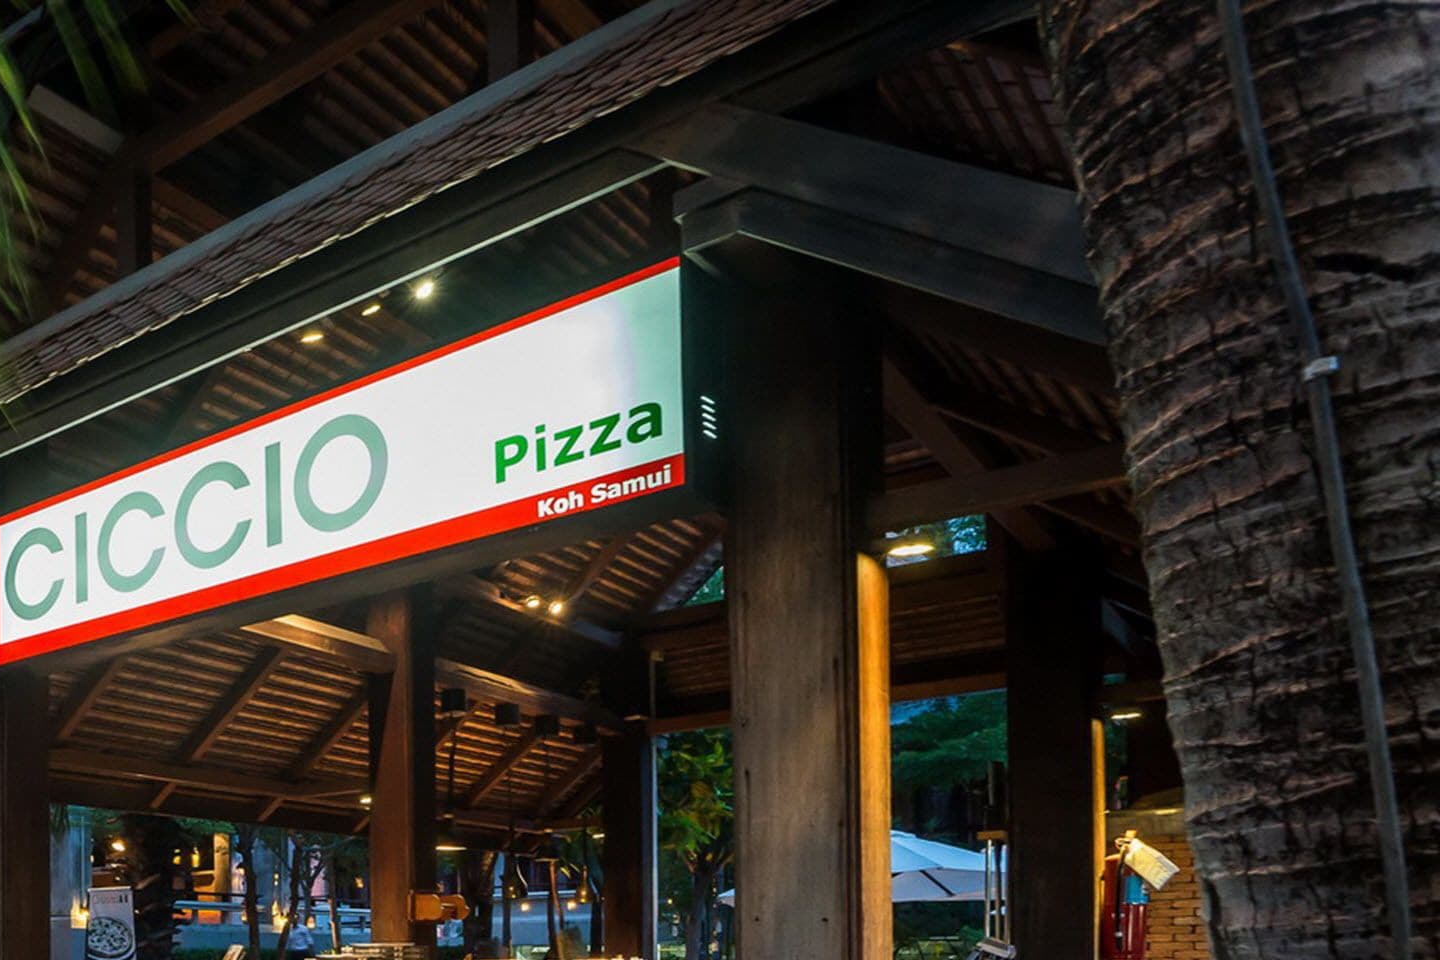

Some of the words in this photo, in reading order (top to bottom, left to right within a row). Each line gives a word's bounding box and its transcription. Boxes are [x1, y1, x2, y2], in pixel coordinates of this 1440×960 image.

[495, 402, 663, 484] Pizza
[5, 414, 389, 621] CICCIO
[537, 491, 585, 518] Koh
[590, 464, 672, 504] Samui
